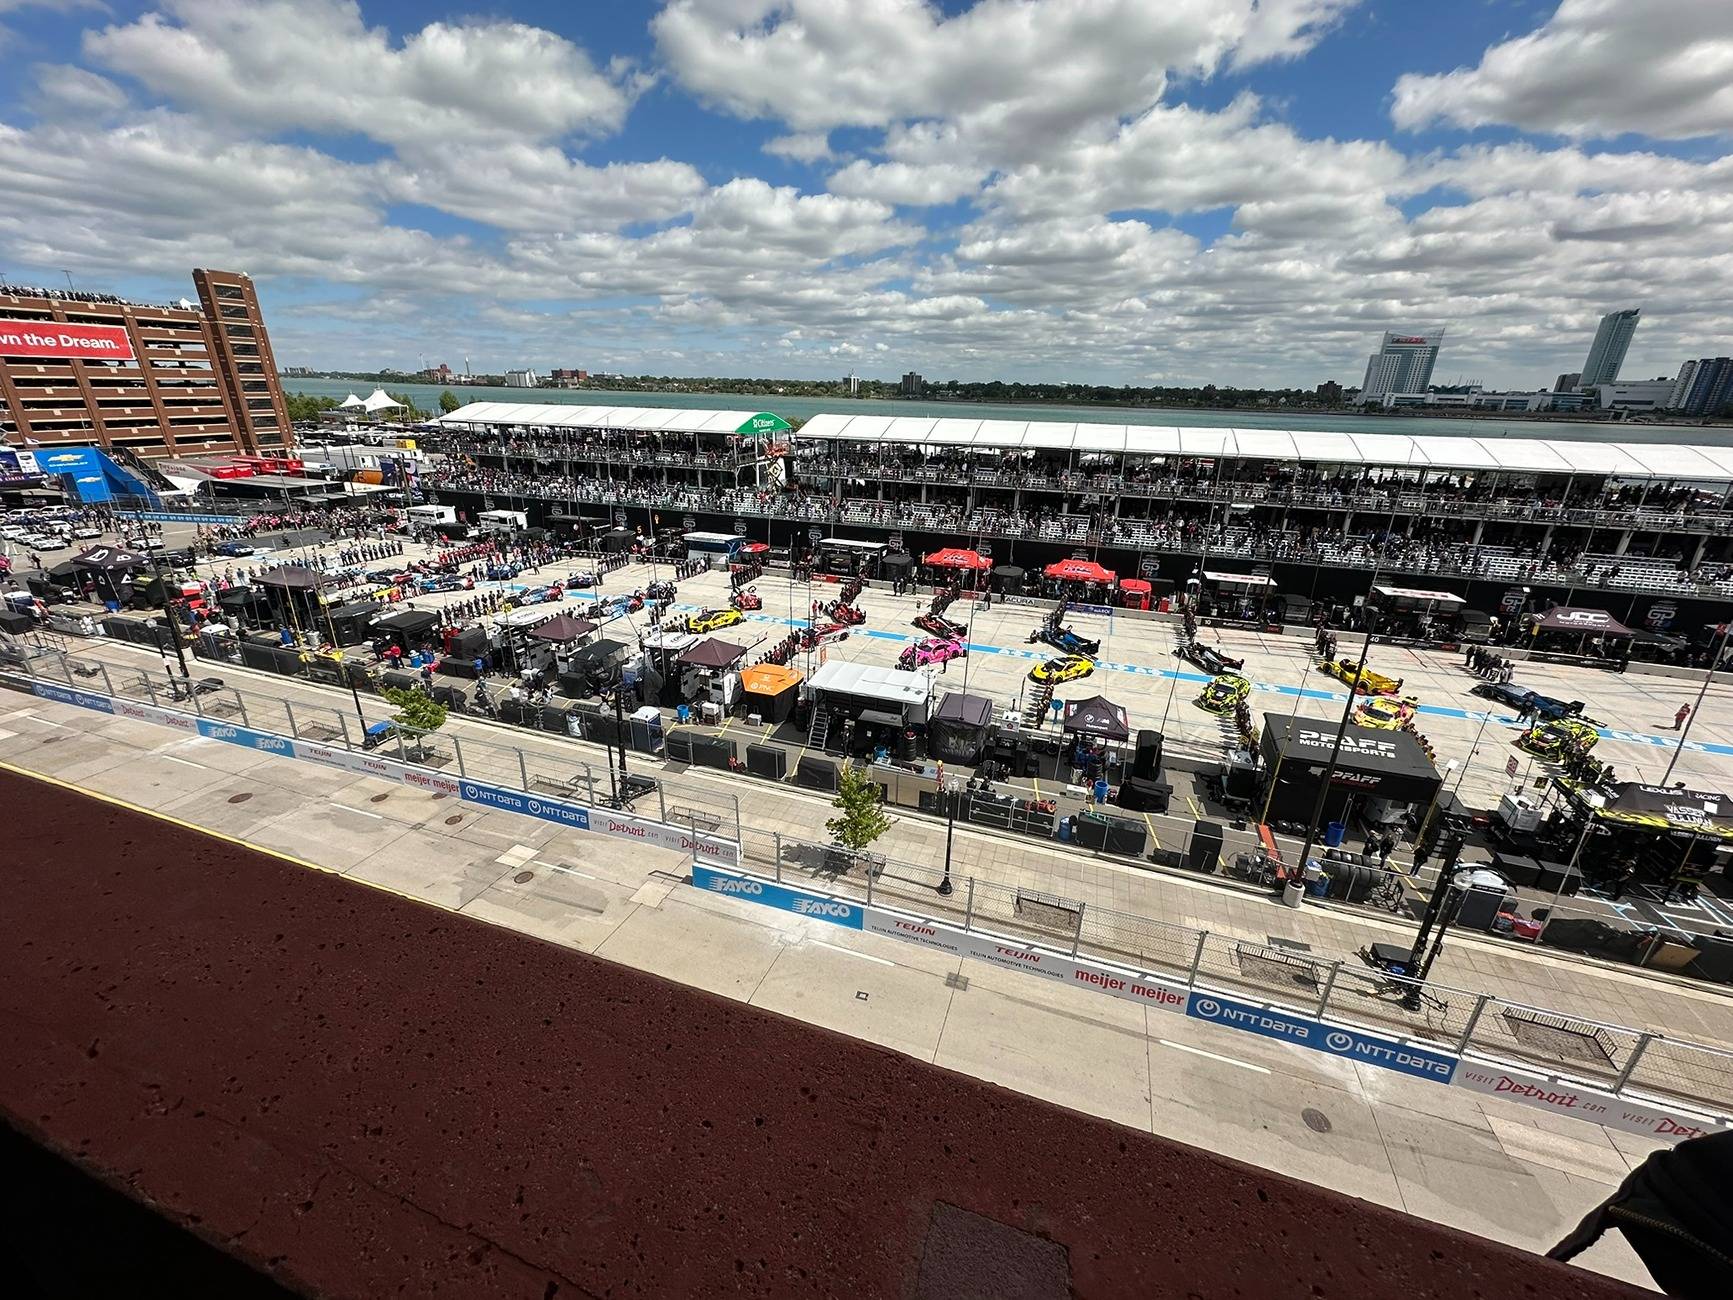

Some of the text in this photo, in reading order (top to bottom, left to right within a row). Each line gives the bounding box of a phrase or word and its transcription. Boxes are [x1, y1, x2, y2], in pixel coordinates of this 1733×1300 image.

[23, 333, 57, 346] the
[58, 334, 120, 349] Dream.
[208, 726, 237, 737] FAYGO
[1299, 729, 1396, 751] PFAFF
[256, 738, 285, 749] FAYGO
[1299, 739, 1396, 758] MOTOSPORTS
[309, 748, 332, 758] TEIJIN
[363, 760, 387, 771] TEIJIN
[404, 772, 430, 786] meijer
[433, 779, 459, 793] meijer
[1331, 770, 1381, 784] PFAFF
[479, 790, 498, 801] NTT
[1639, 785, 1684, 796] LEXUS
[542, 805, 562, 816] NTT
[608, 819, 646, 837] Detroit
[711, 877, 763, 895] FAYGO
[794, 899, 851, 918] FAYGO
[894, 920, 936, 936] TEIJIN
[871, 925, 958, 951] TEIJIN AUTOMOTIVE TECHNOLOGIES
[994, 945, 1041, 962] TEIJIN
[970, 950, 1064, 979] TEIJIN AUTOMOTIVE TECHNOLOGIES
[1075, 969, 1184, 1006] meijer meijer
[1223, 1008, 1260, 1025] NTT
[1355, 1042, 1397, 1060] NTT
[1464, 1071, 1495, 1085] VISIT
[1494, 1075, 1580, 1107] Detroit
[1622, 1112, 1655, 1126] VISIT
